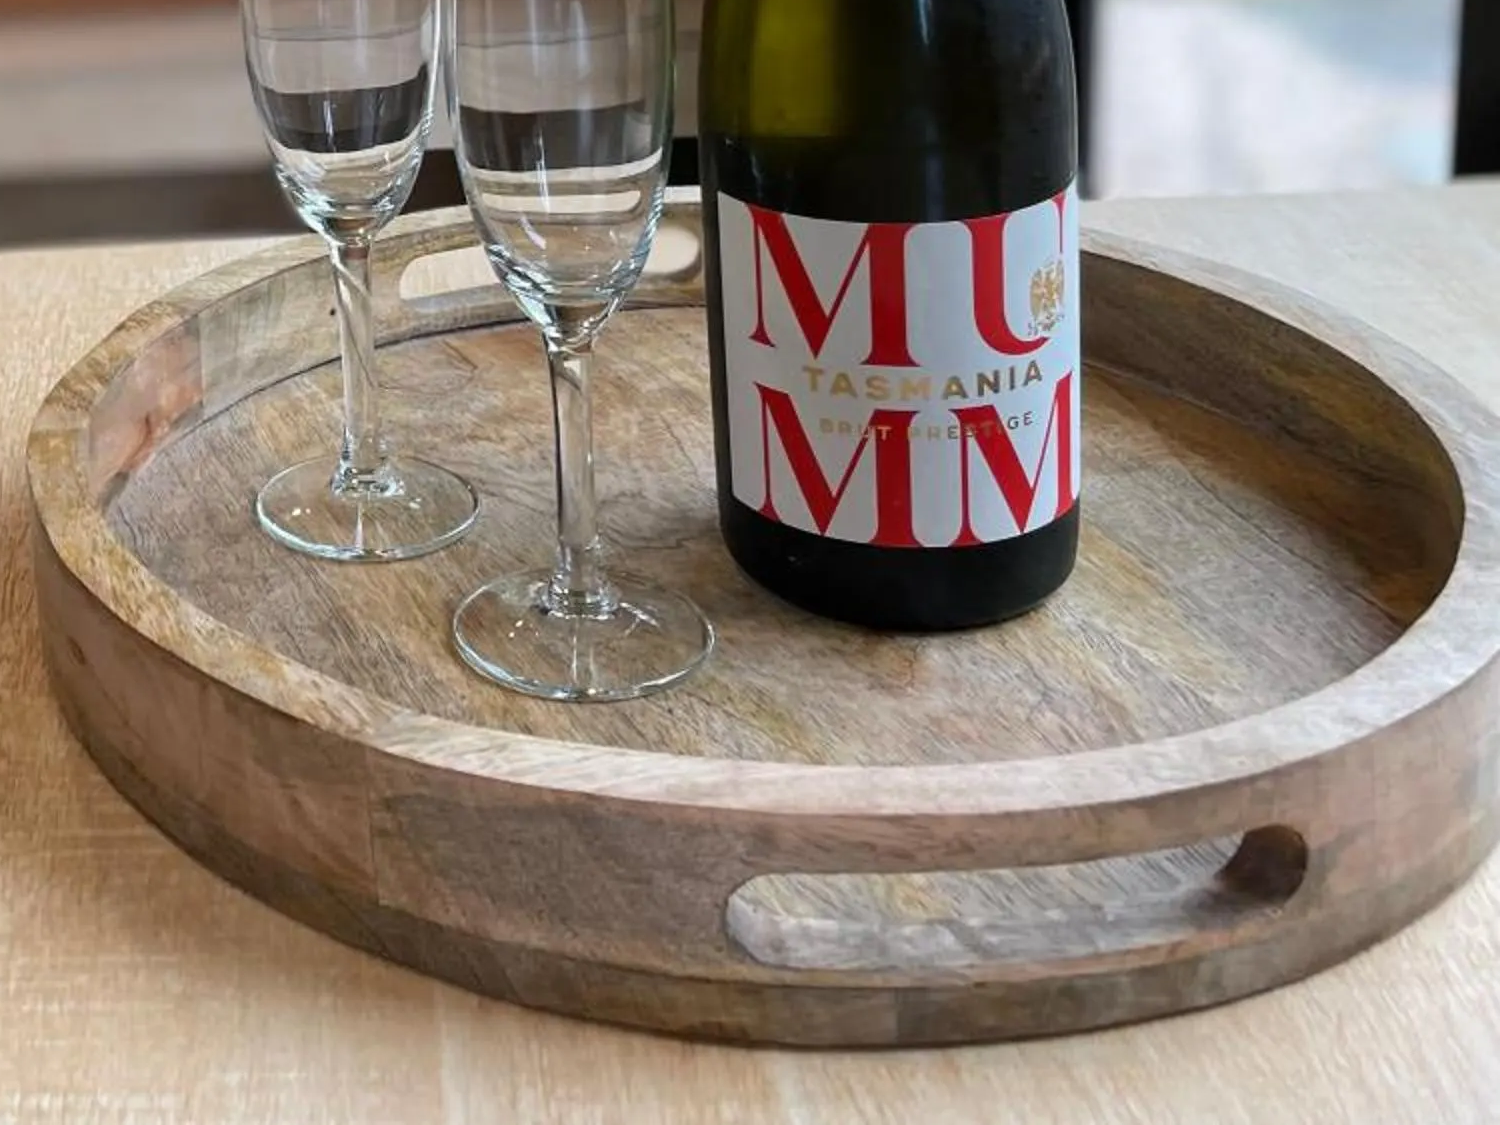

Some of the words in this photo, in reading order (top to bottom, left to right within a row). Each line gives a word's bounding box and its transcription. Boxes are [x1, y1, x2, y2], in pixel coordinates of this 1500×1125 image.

[748, 192, 1065, 367] MU
[753, 371, 1074, 548] MM
[803, 360, 1043, 401] TASMANIA
